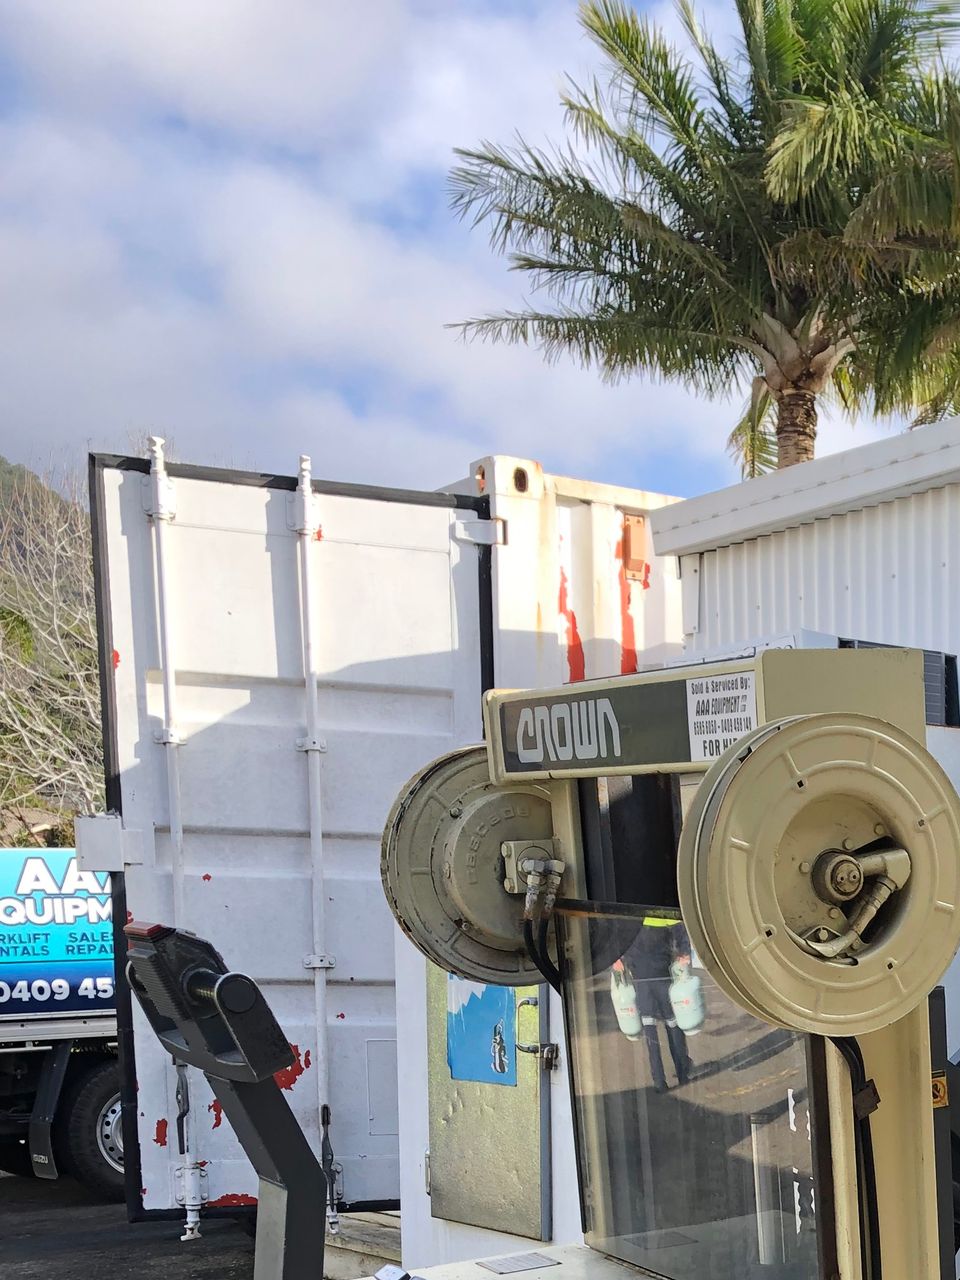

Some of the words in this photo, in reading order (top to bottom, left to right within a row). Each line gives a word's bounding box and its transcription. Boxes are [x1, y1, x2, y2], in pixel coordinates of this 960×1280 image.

[691, 681, 703, 695] Sold
[705, 681, 710, 694] &
[711, 677, 739, 693] Serviced
[740, 675, 751, 690] By:
[695, 699, 710, 716] AAA
[711, 695, 740, 715] EQUIPMENT
[517, 698, 621, 763] CROWN
[703, 739, 721, 757] FOR
[16, 857, 112, 895] AA
[78, 977, 114, 999] 45
